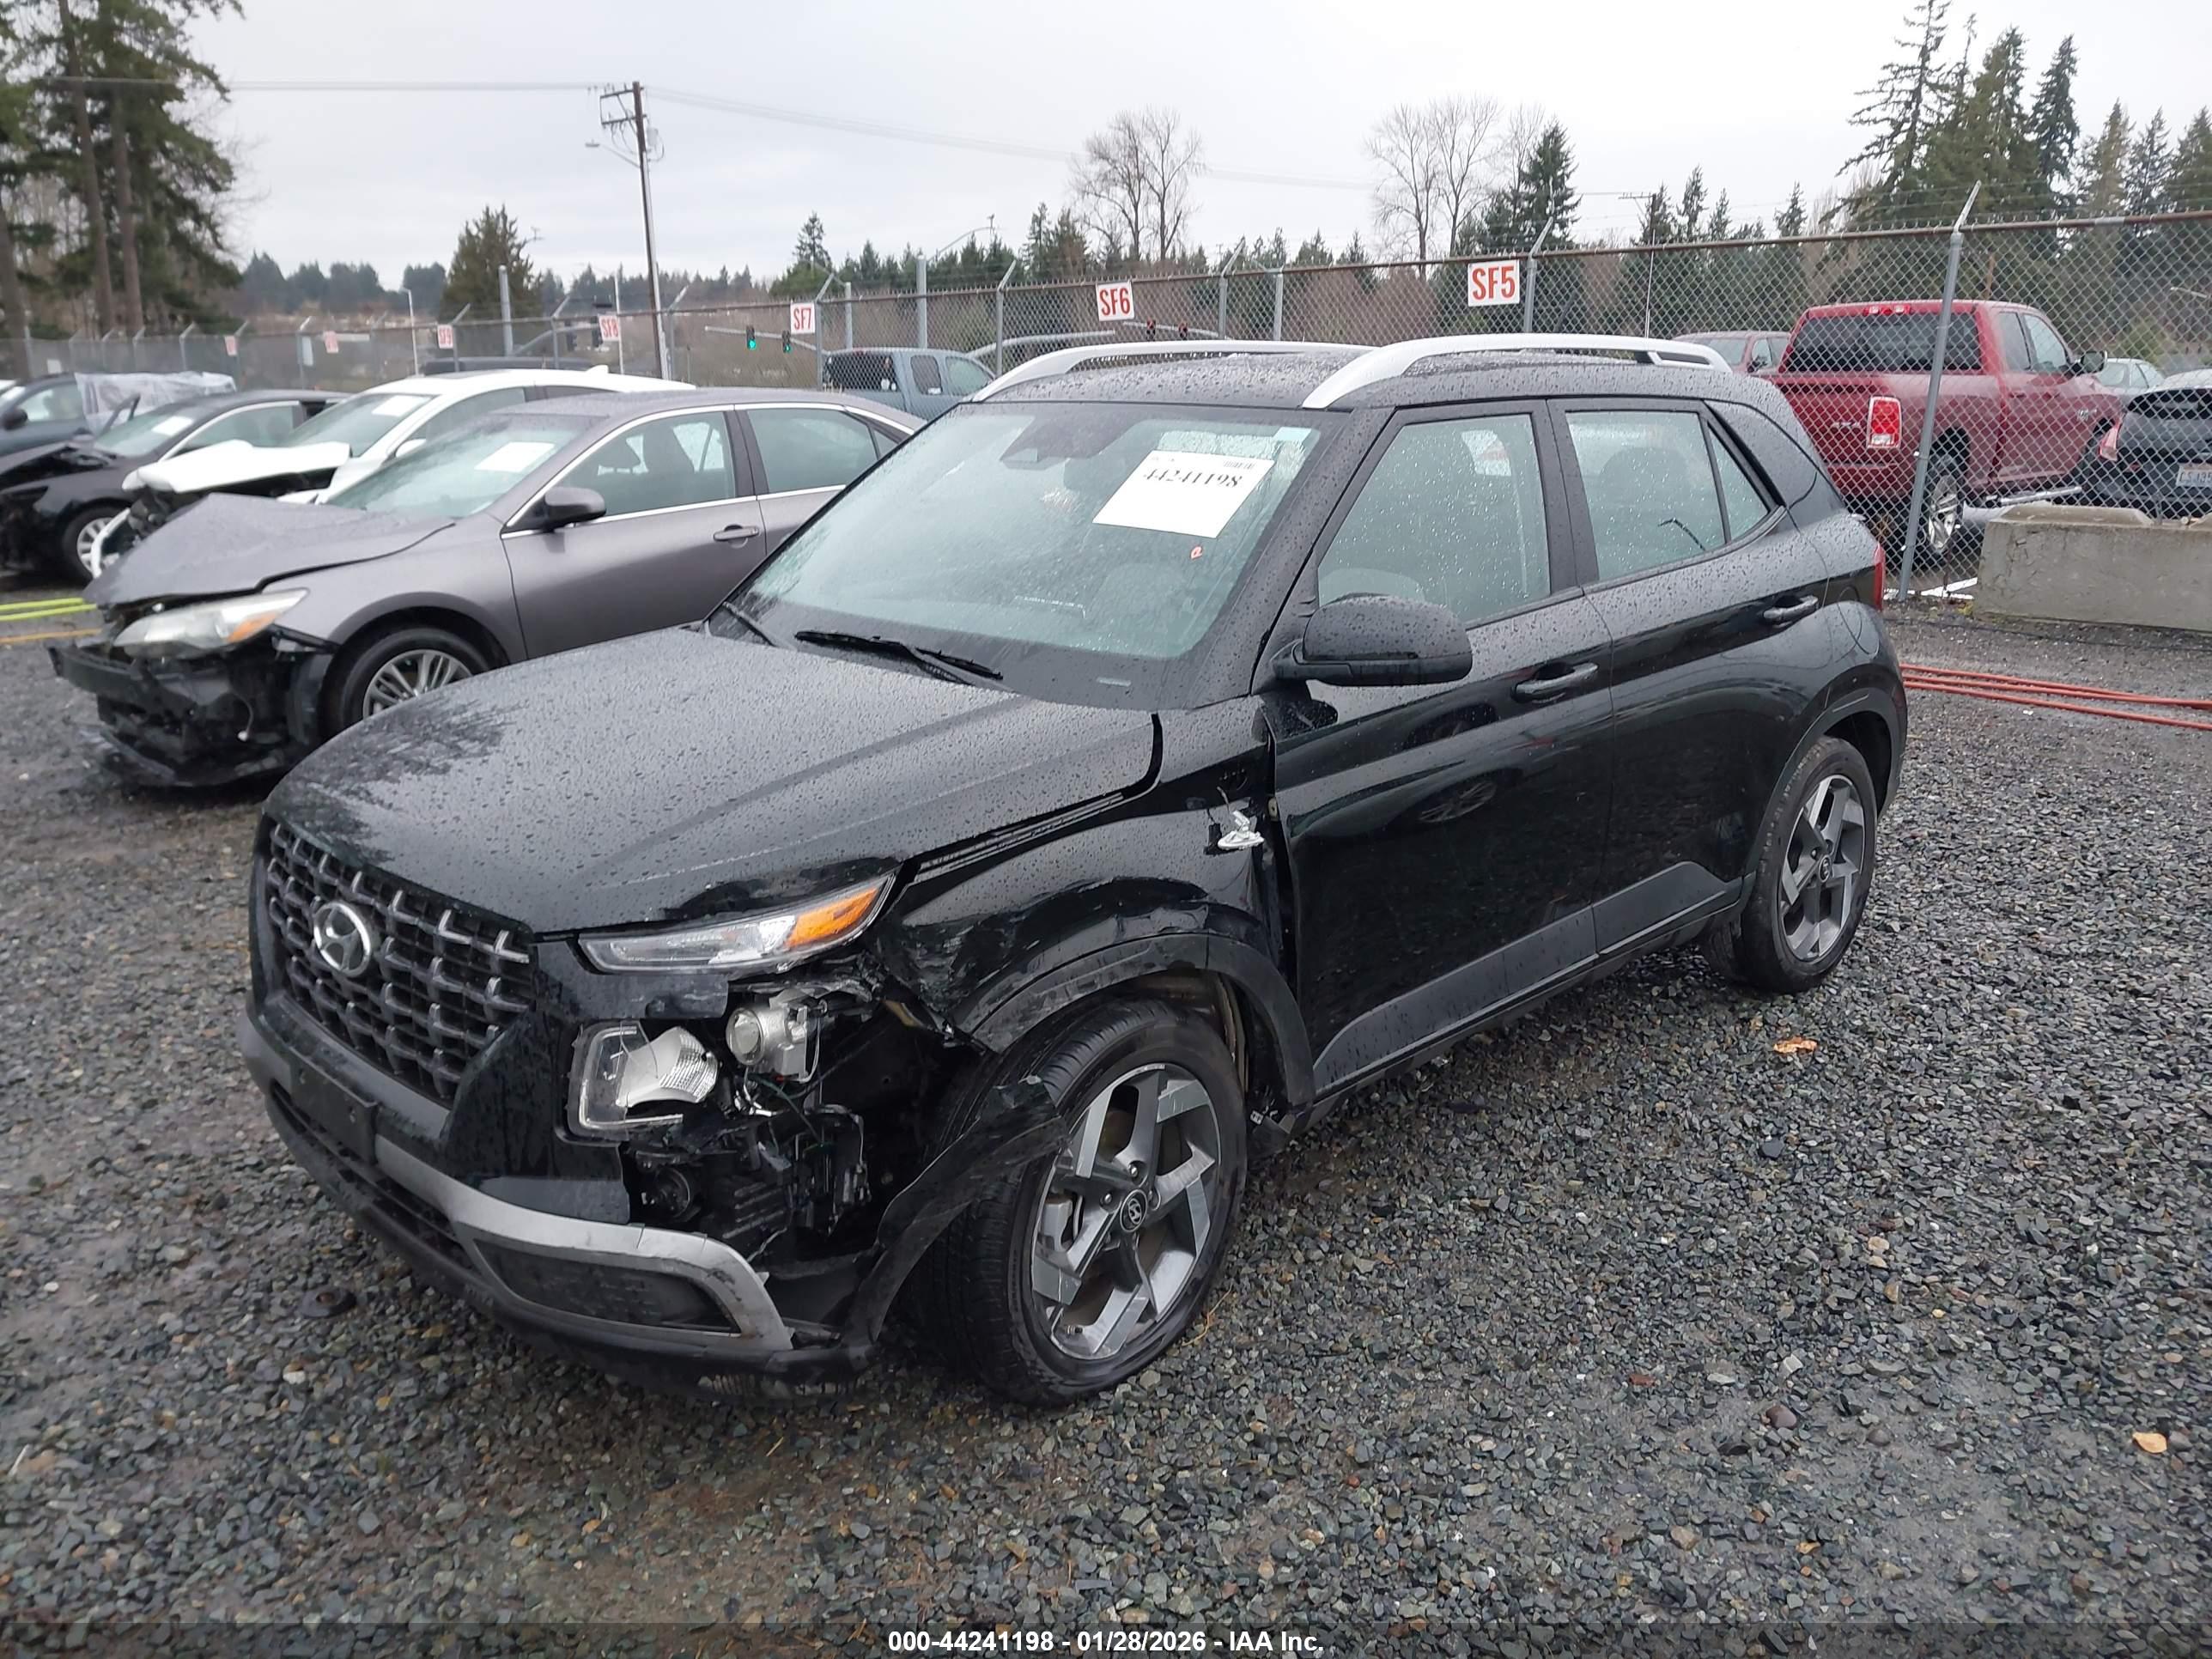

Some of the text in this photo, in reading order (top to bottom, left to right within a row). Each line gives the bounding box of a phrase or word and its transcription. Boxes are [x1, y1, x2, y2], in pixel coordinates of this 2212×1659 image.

[1472, 265, 1516, 300] SF5
[1098, 288, 1132, 317] SF6
[601, 316, 619, 337] SF8
[793, 307, 811, 331] SF7
[1144, 469, 1243, 487] 44241198
